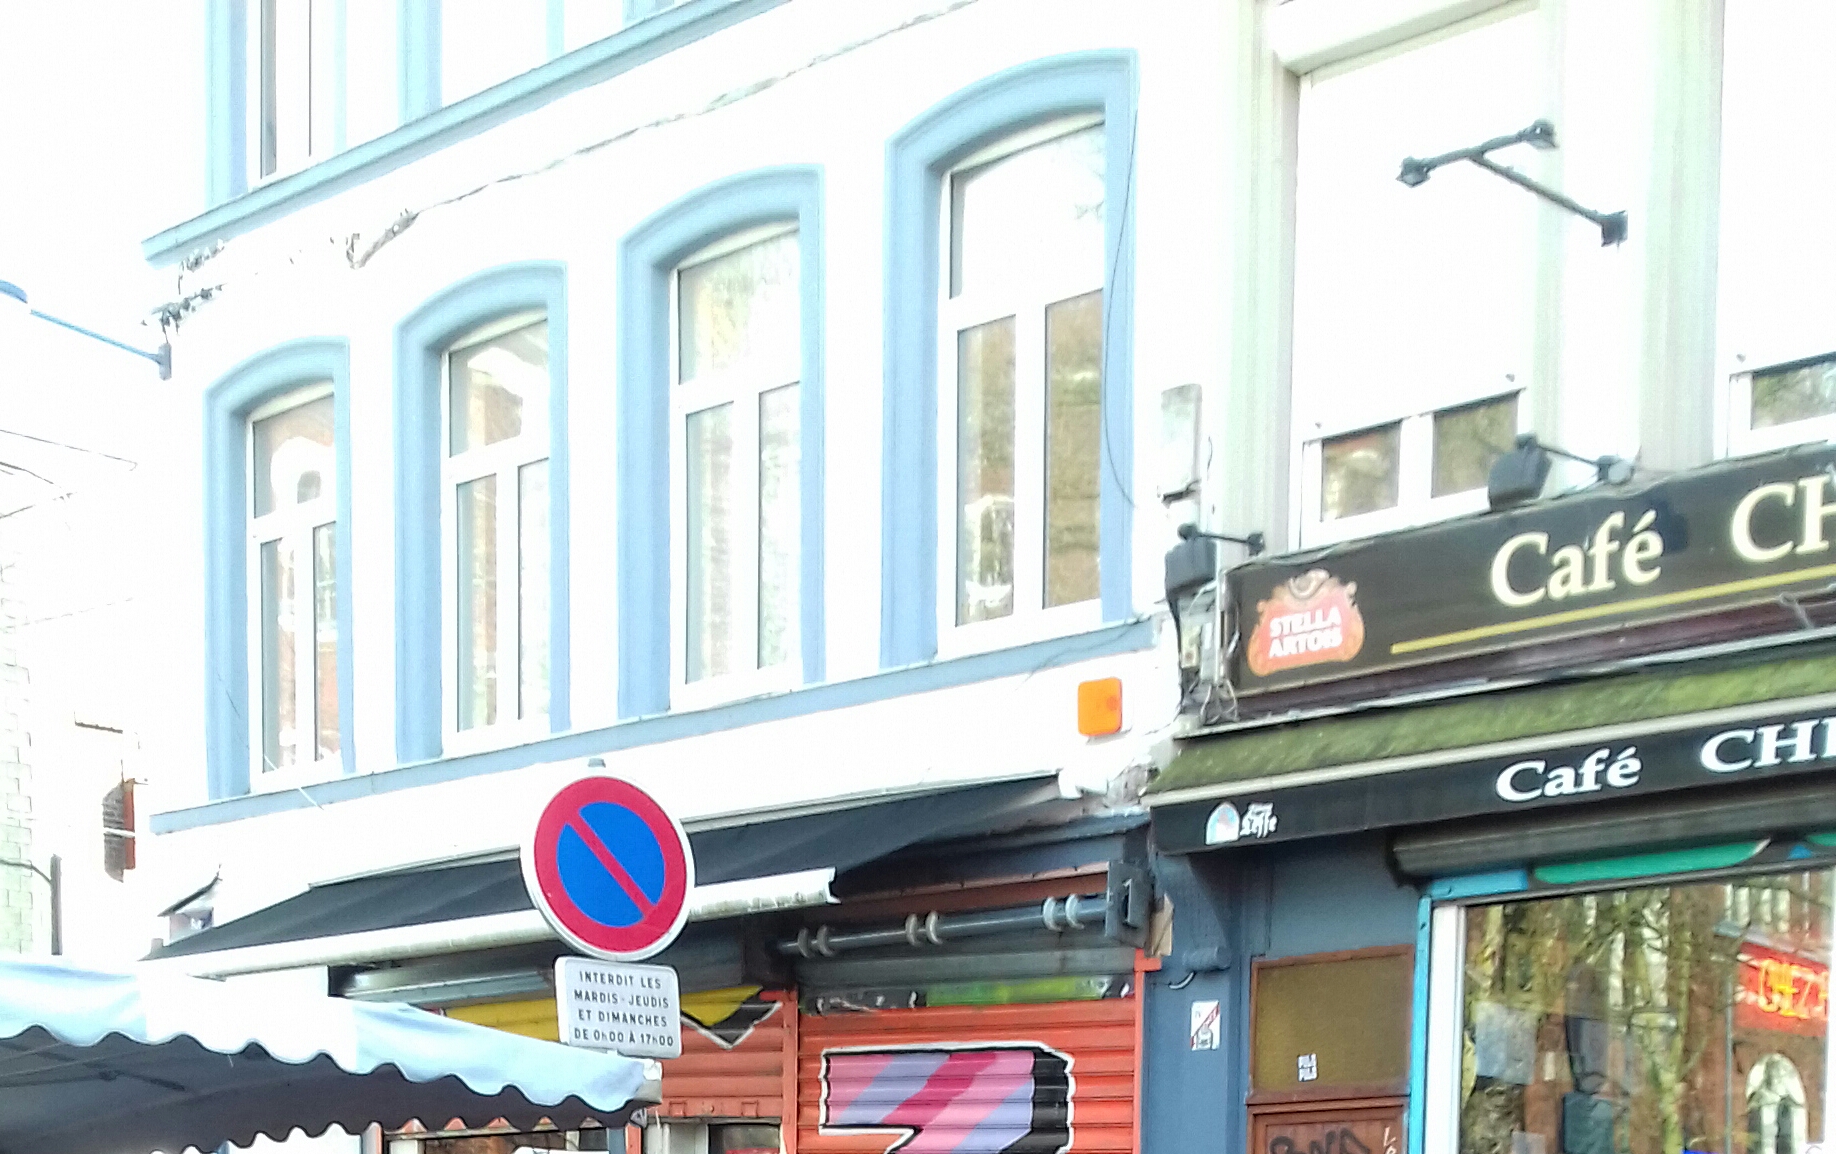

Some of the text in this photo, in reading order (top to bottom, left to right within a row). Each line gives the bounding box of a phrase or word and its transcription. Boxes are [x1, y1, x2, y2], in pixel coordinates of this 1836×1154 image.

[1491, 510, 1664, 606] Café
[1269, 607, 1342, 637] STELLA
[1268, 627, 1343, 658] ARTOIS
[1495, 746, 1642, 801] Café
[579, 970, 662, 989] INTERDIT LES
[573, 988, 618, 1004] MARDIS
[628, 994, 669, 1009] JEUDIS
[578, 1008, 667, 1027] ET DIMANCHES
[574, 1027, 588, 1040] DE
